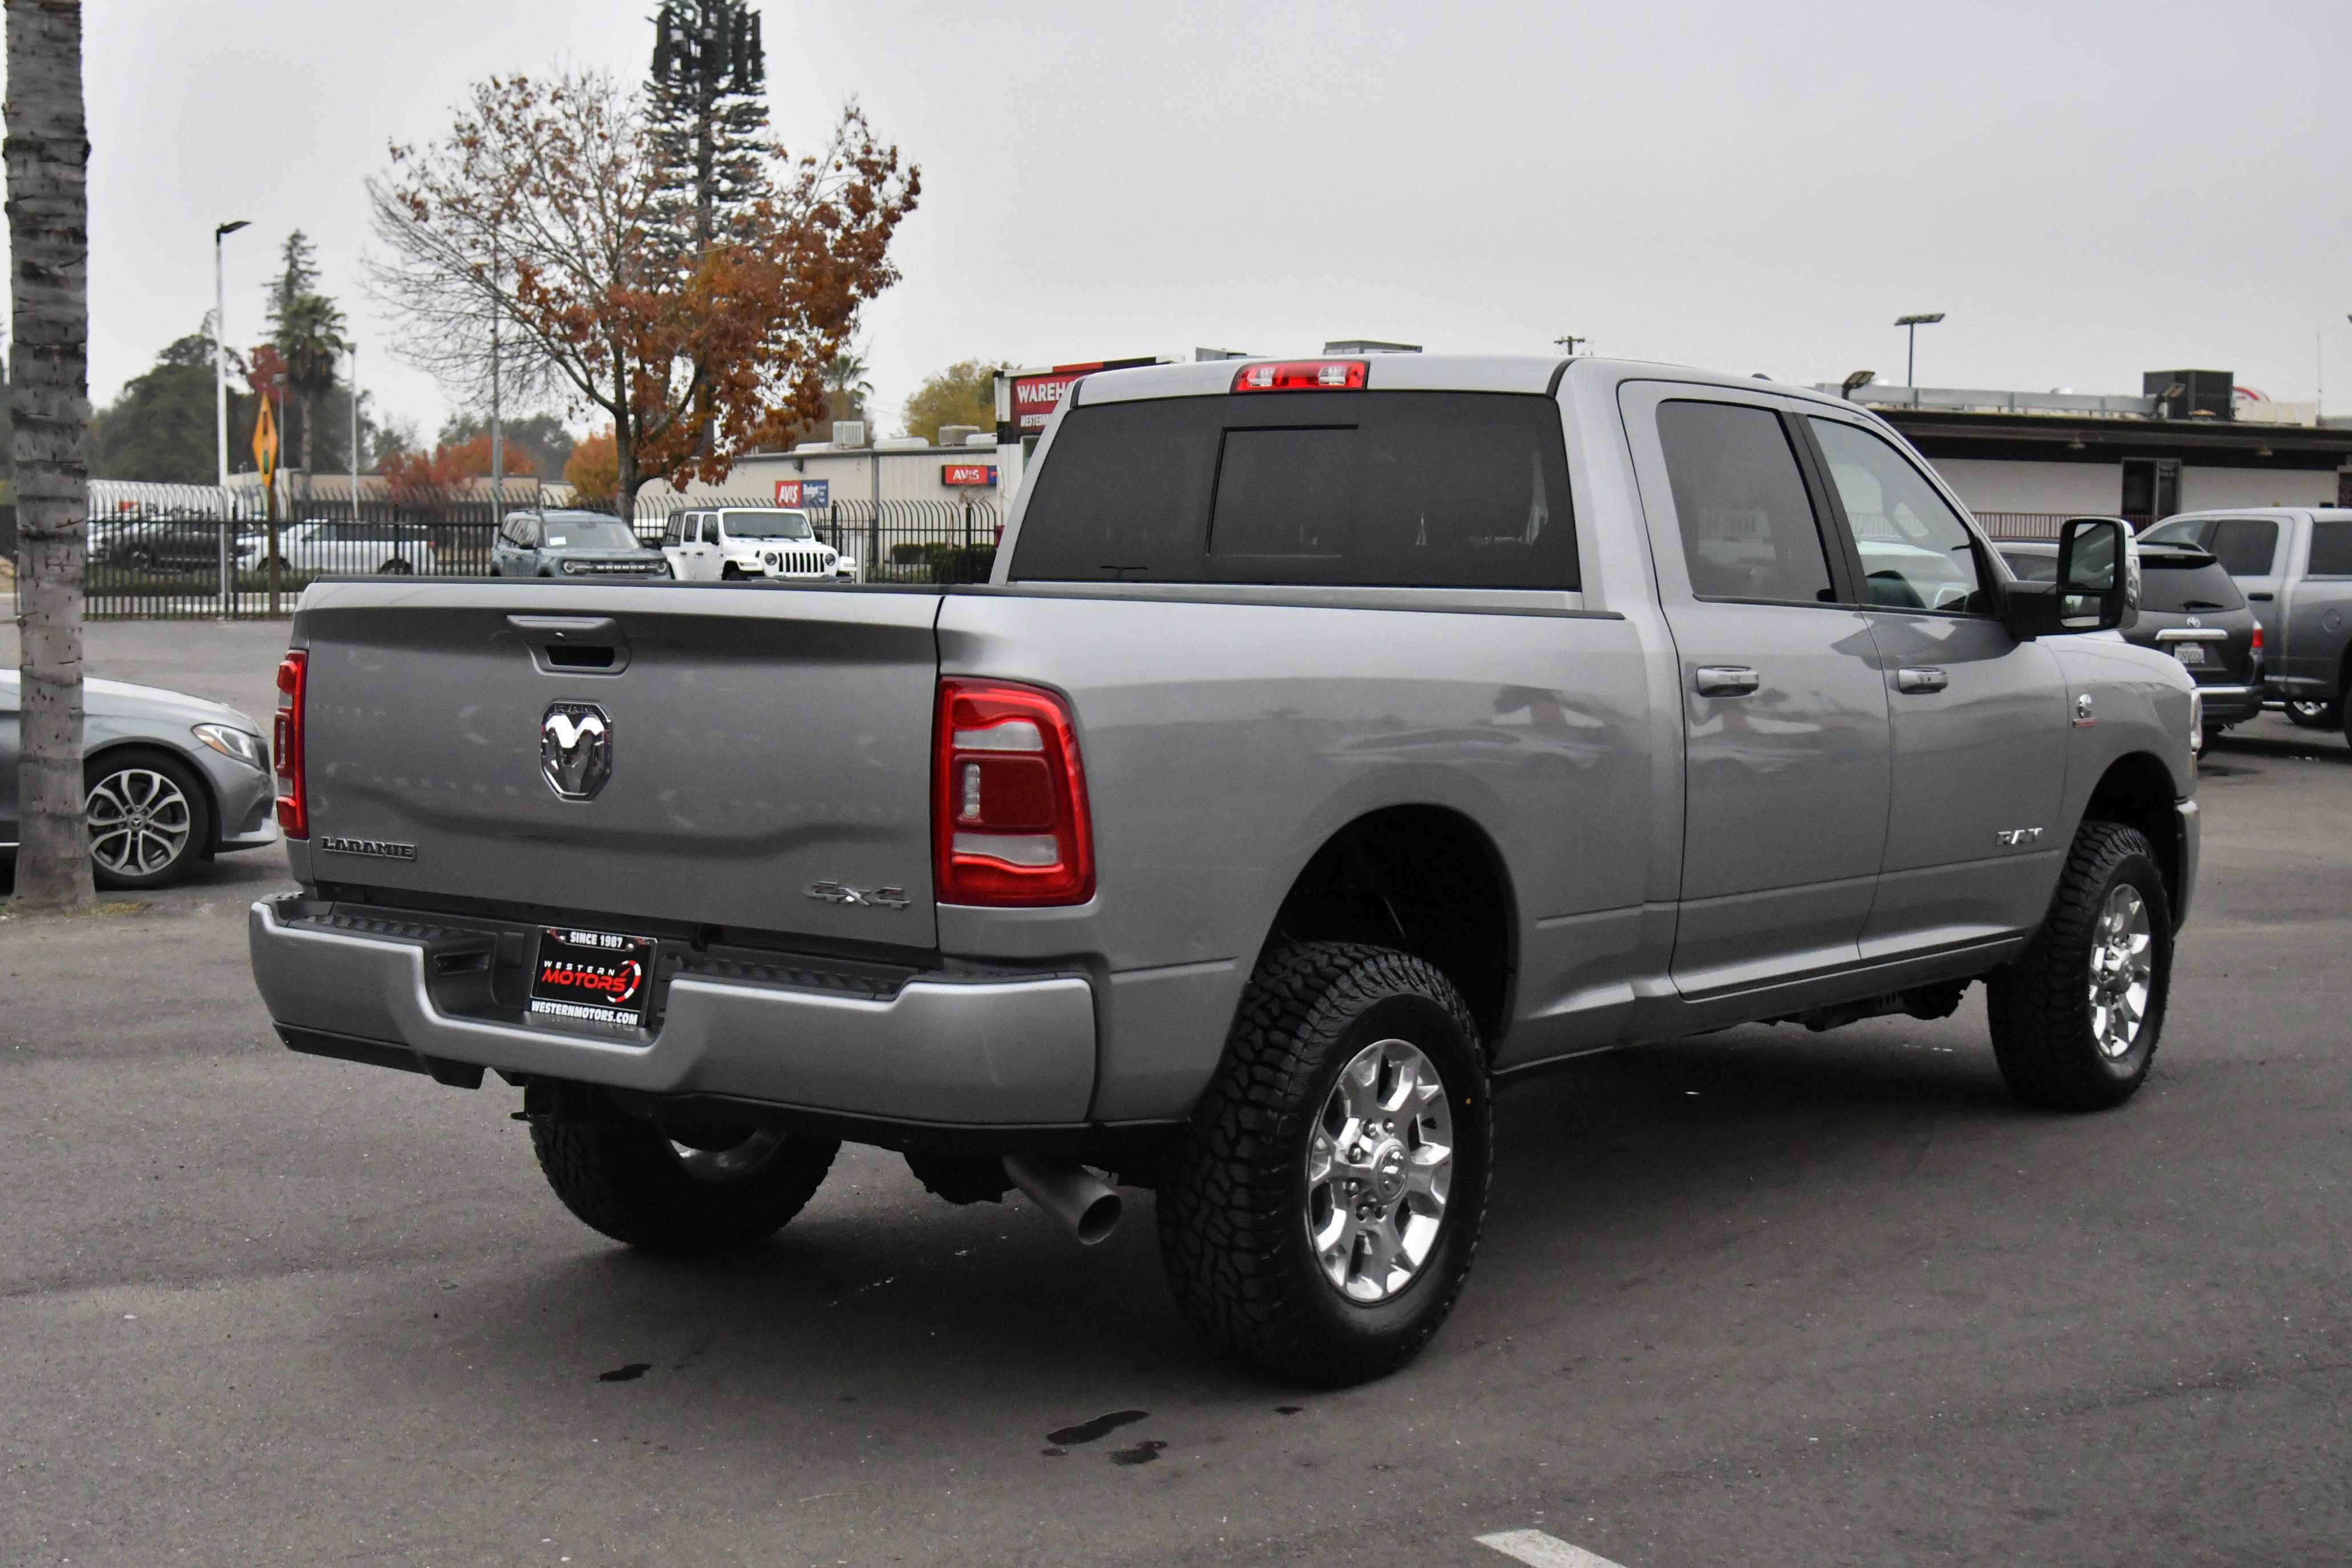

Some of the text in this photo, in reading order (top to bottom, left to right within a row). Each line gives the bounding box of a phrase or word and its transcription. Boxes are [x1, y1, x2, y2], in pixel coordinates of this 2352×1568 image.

[1017, 382, 1066, 403] WAREH
[952, 469, 980, 480] AVIS
[778, 484, 799, 503] AVIS
[321, 836, 418, 860] LARAMIE
[570, 931, 623, 948] SINCE 1987
[544, 960, 615, 976] WESTERN
[541, 968, 627, 993] MOTORS
[531, 1000, 638, 1025] WESTERNMOTORS.COM
